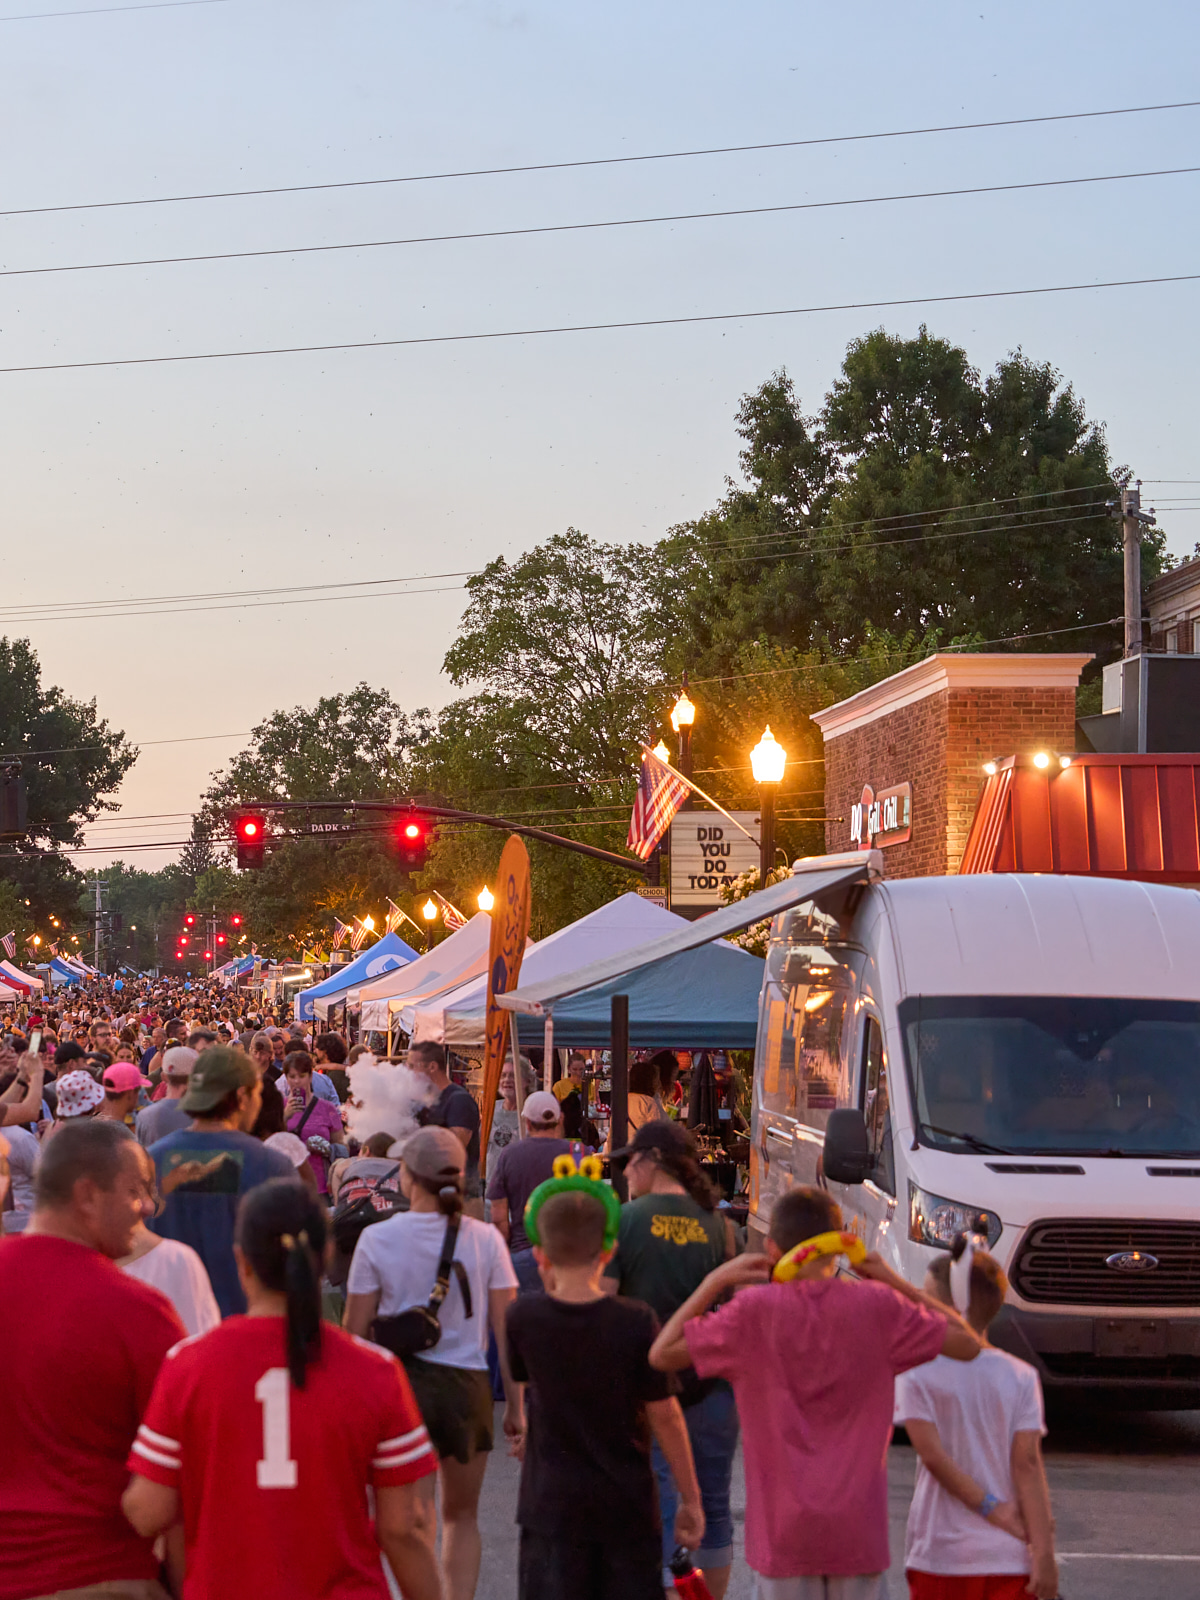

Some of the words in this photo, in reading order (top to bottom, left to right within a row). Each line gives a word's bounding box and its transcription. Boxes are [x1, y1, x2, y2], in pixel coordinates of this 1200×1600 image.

[311, 823, 339, 833] PARK
[851, 802, 862, 844] DQ
[697, 827, 723, 841] DID
[700, 843, 730, 857] YOU
[704, 859, 726, 873] DQ
[687, 875, 739, 889] TODAY
[1117, 1255, 1147, 1268] Ford
[255, 1367, 298, 1489] 1
